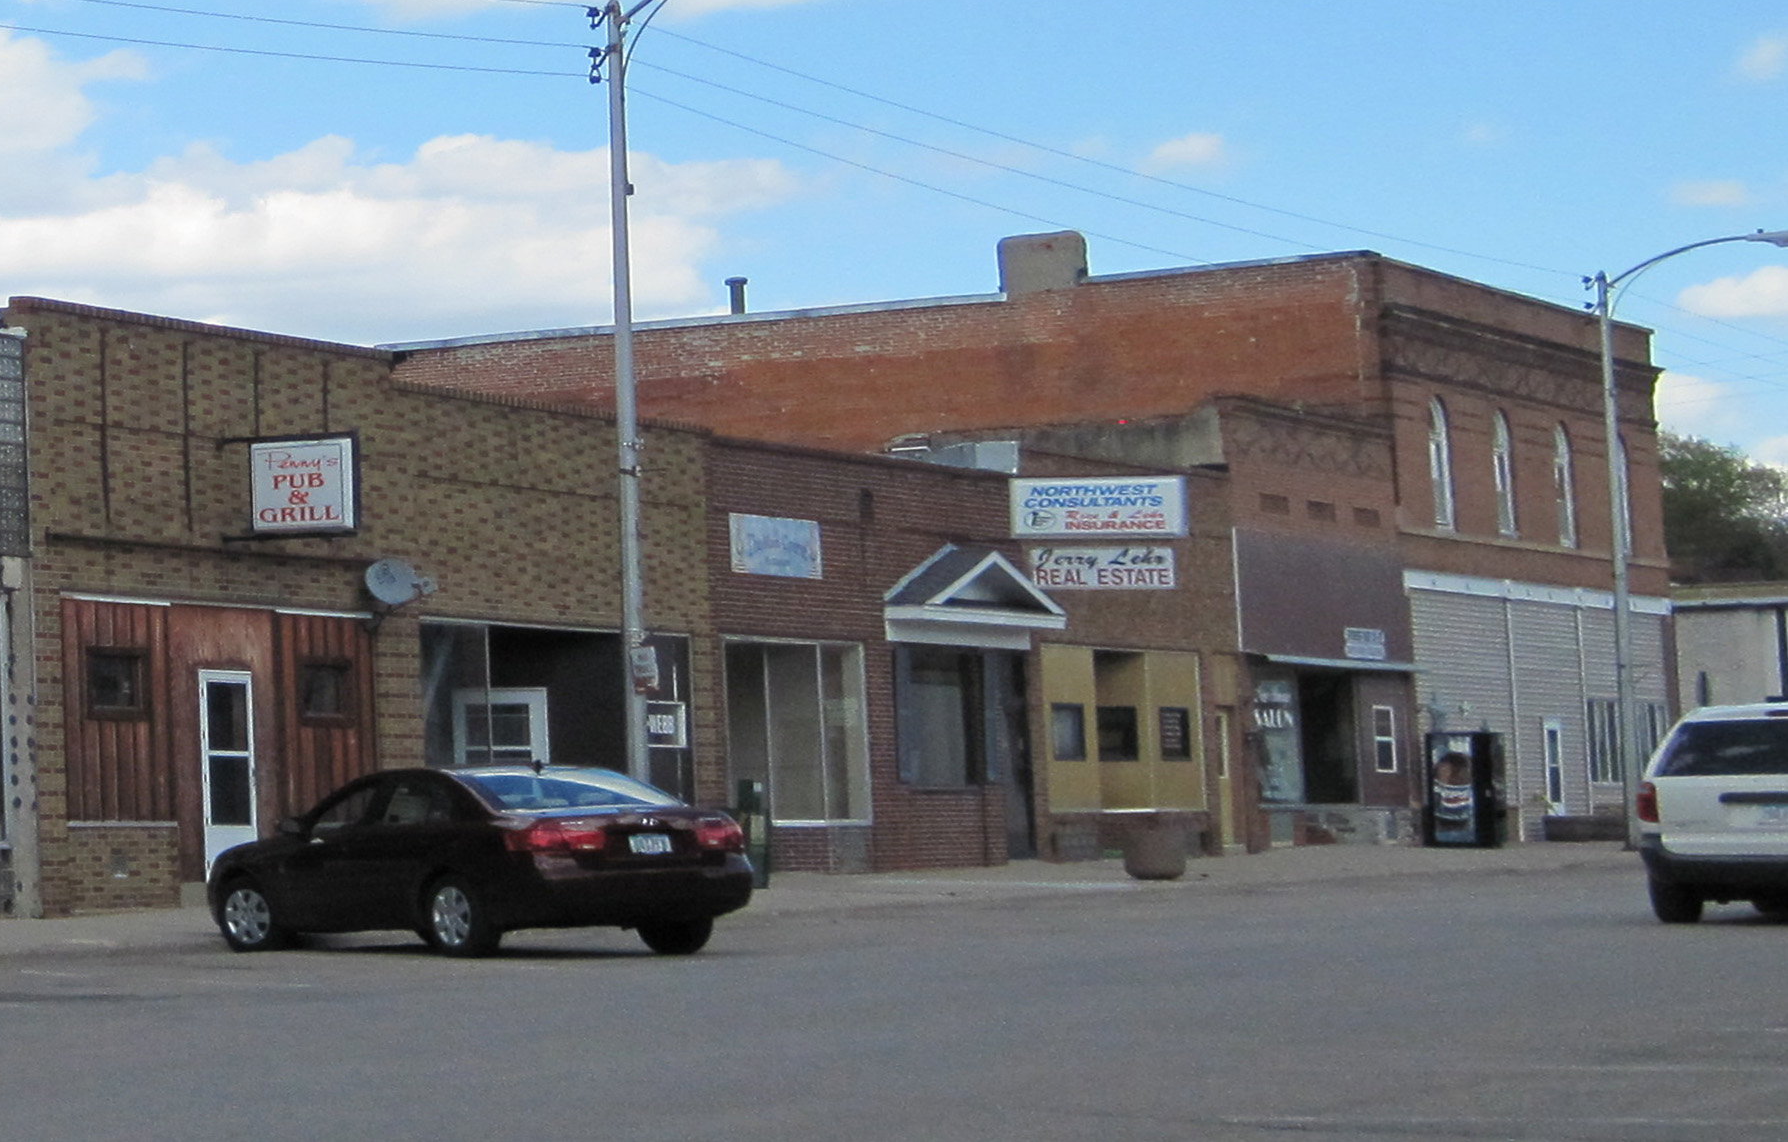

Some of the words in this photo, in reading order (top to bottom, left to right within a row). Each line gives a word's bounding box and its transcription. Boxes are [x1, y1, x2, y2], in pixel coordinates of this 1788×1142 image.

[273, 472, 325, 490] PUB
[288, 490, 310, 505] &
[1030, 484, 1158, 497] NORTHWEST
[1025, 495, 1164, 509] CONSULTANTS
[259, 505, 340, 523] GRILL
[1065, 520, 1166, 530] INSURANCE
[1036, 568, 1088, 585] REAL
[1097, 568, 1171, 585] ESTATE
